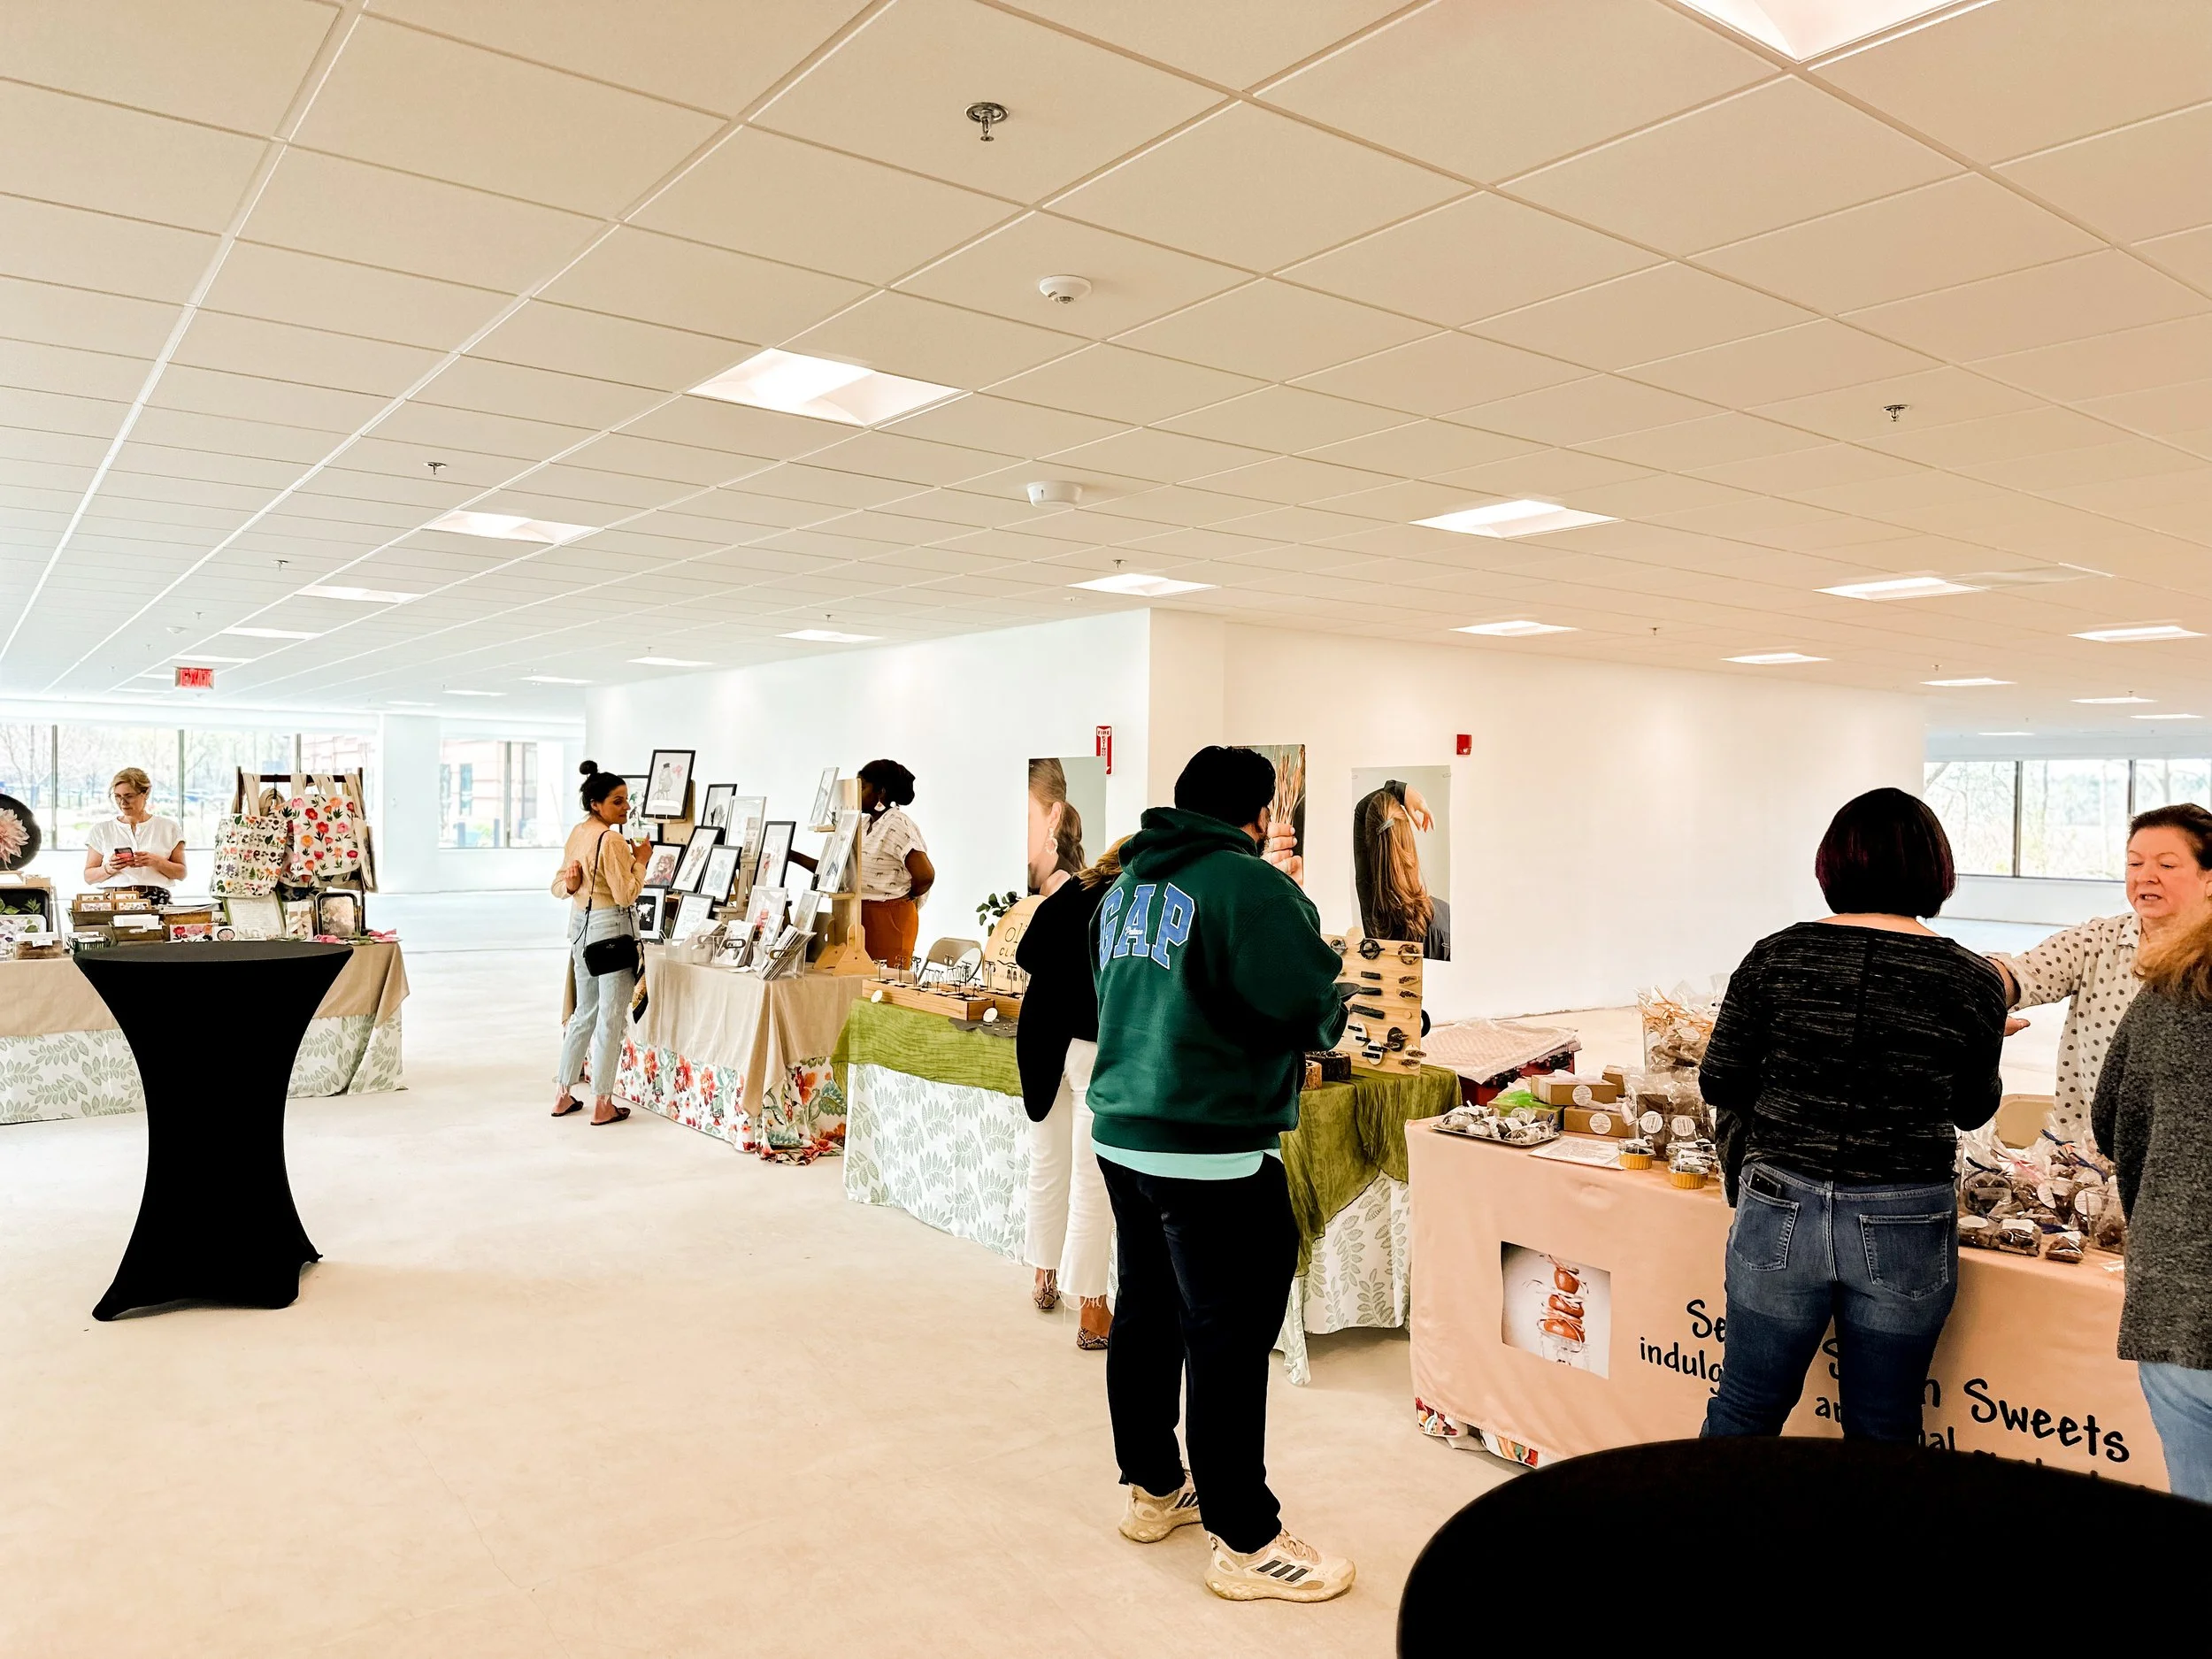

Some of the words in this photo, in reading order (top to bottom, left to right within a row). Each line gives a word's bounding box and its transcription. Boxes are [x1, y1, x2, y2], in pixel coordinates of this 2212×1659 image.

[180, 669, 211, 687] EXIT
[999, 947, 1016, 958] CLA
[1099, 882, 1194, 972] GAP
[1640, 1336, 1722, 1395] indulg
[1963, 1378, 2130, 1463] Sweets
